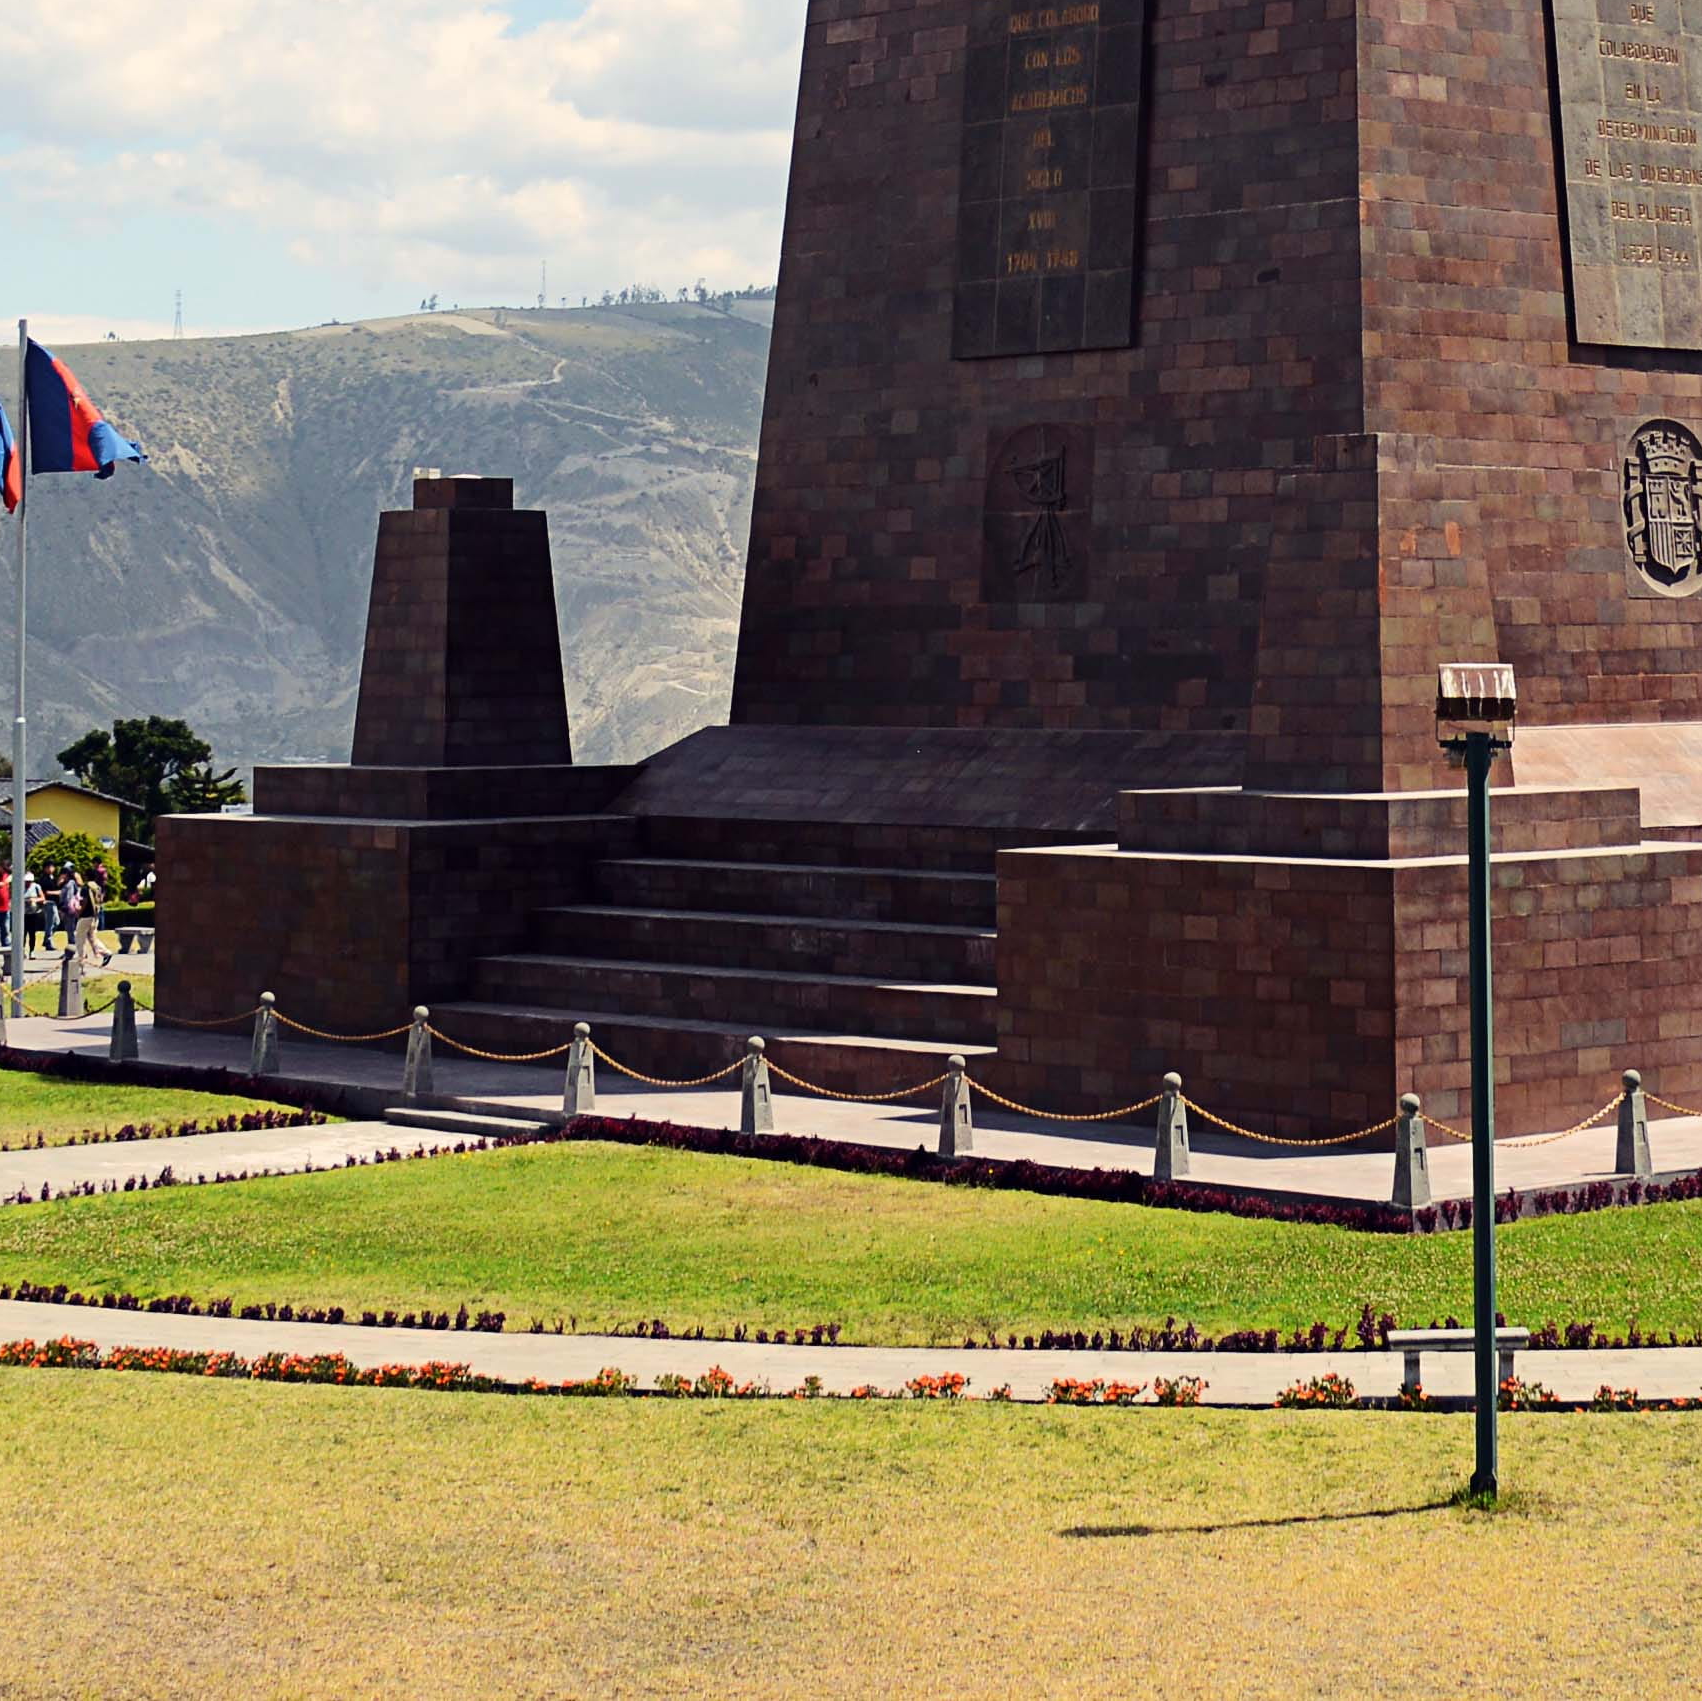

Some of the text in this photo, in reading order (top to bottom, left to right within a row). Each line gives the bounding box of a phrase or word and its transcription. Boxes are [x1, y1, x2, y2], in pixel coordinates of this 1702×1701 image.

[1630, 3, 1655, 25] QUE
[1025, 44, 1082, 69] CON LOS
[1599, 38, 1679, 66] COLABORARON
[1625, 82, 1661, 104] EN LA
[1597, 118, 1697, 147] DETERMINACION
[1585, 158, 1601, 178] DE
[1608, 161, 1633, 181] LAS
[1611, 201, 1692, 226] DEL PLANETA
